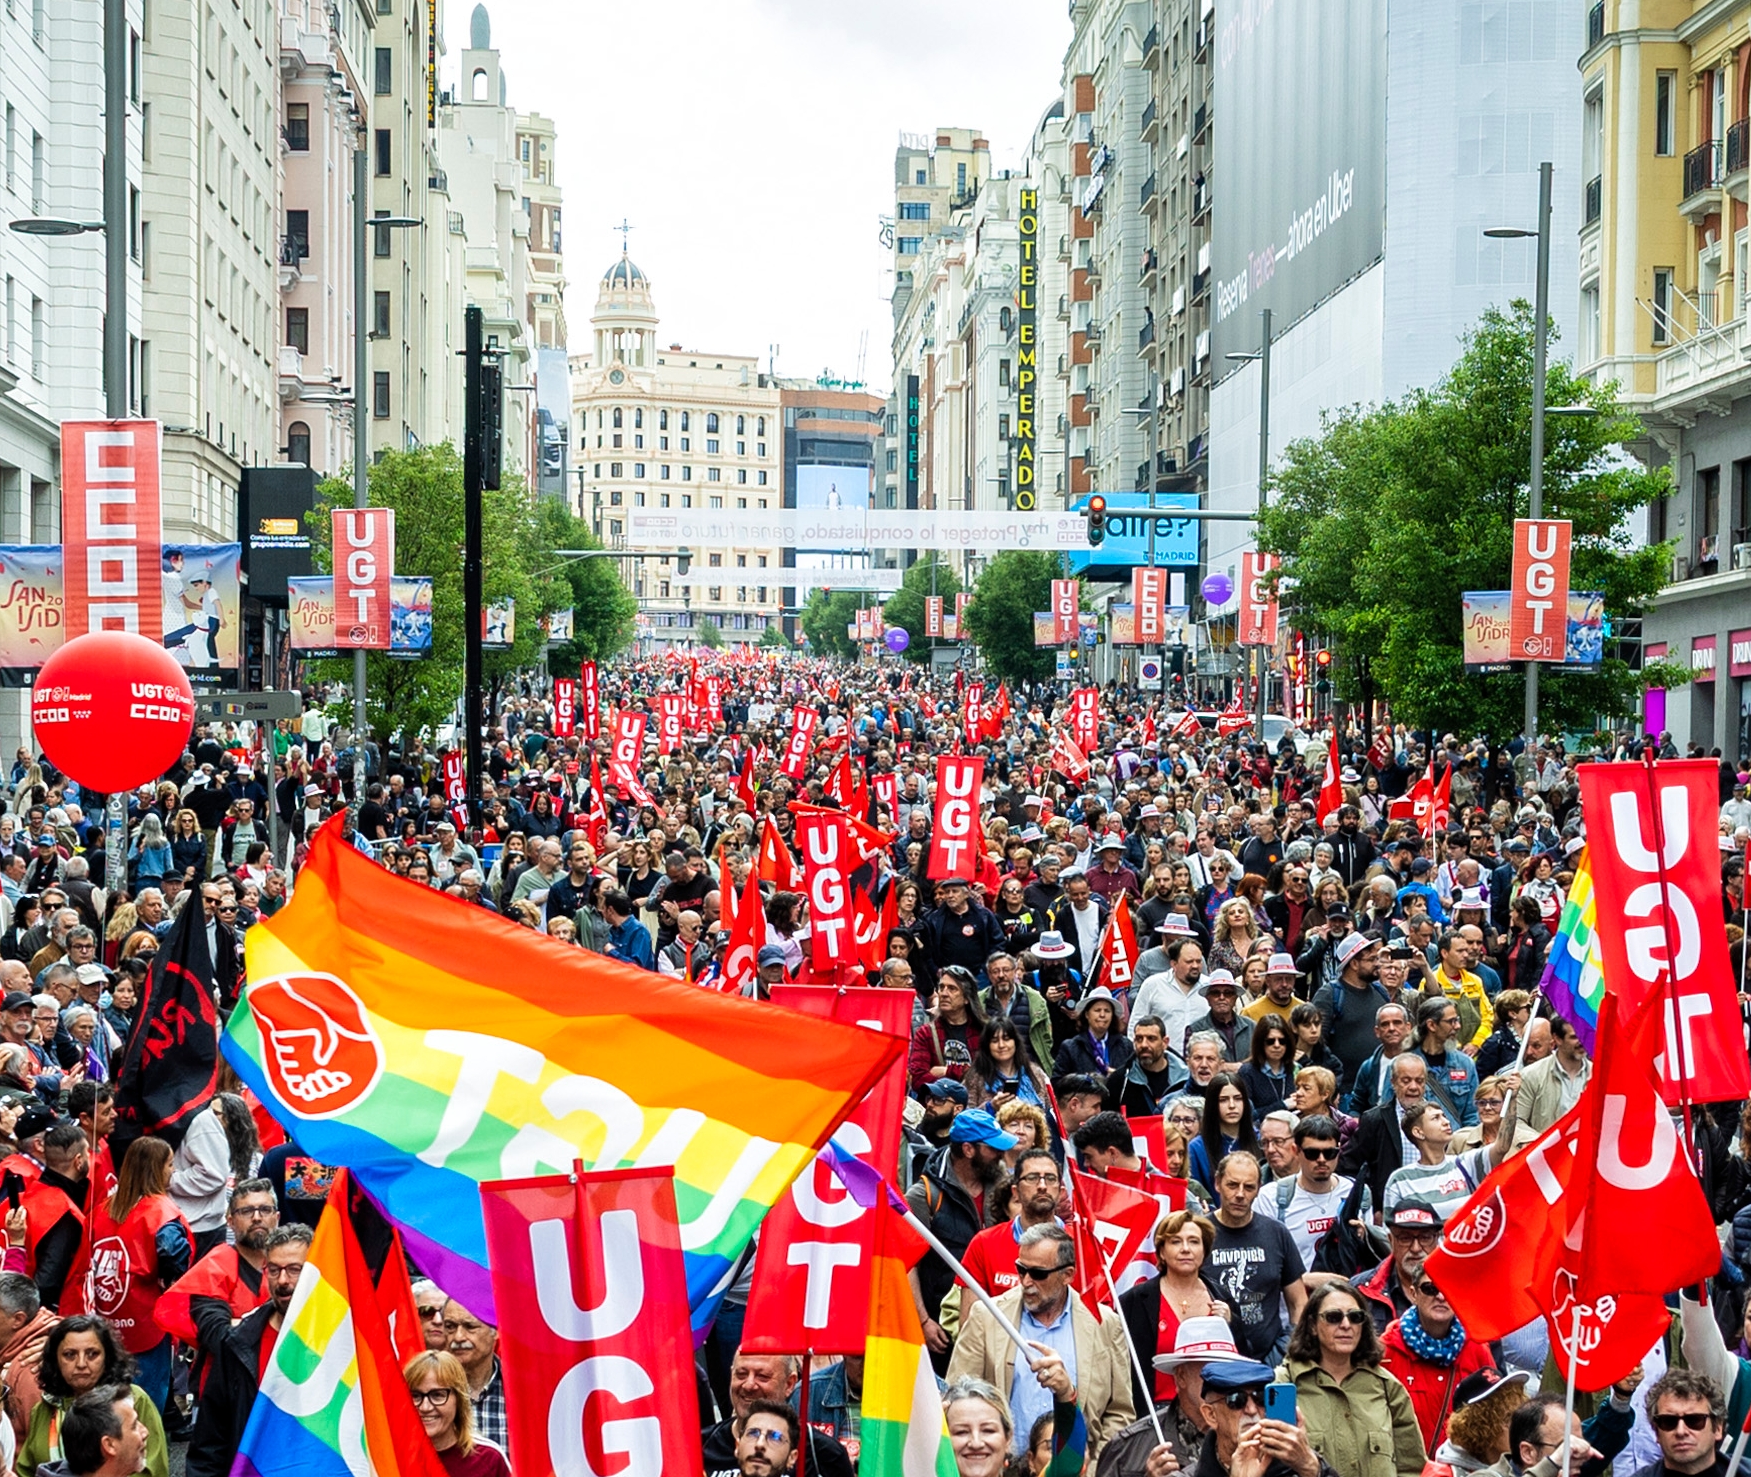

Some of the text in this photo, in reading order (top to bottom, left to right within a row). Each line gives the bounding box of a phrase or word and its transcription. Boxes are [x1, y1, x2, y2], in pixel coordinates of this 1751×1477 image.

[1216, 268, 1248, 323] Reserva
[1326, 166, 1355, 226] Uber
[1016, 190, 1037, 510] HOTEL EMPERADO
[909, 397, 918, 481] HOTEL
[347, 514, 376, 622] UGT
[1155, 552, 1195, 561] MADRID
[1525, 525, 1556, 634] UGT
[46, 595, 64, 606] 20
[1059, 581, 1073, 631] UGT
[1143, 571, 1158, 635] CCOO
[1251, 553, 1270, 629] UGT
[19, 608, 61, 632] ISID
[302, 611, 335, 628] ISIDR
[1468, 612, 1493, 630] SAN
[1477, 622, 1510, 645] ISIDR
[130, 704, 181, 721] CCOO
[131, 682, 164, 701] UGT
[559, 682, 571, 734] UGT
[708, 680, 721, 720] UGT
[968, 688, 979, 740] UGT
[616, 716, 641, 764] UG
[790, 711, 813, 775] UGT
[447, 759, 468, 826] UGT
[938, 765, 974, 871] UGT
[807, 824, 849, 958] UGT
[1307, 1219, 1329, 1232] UGT
[1396, 1210, 1420, 1222] UGT
[994, 1273, 1020, 1287] UGT
